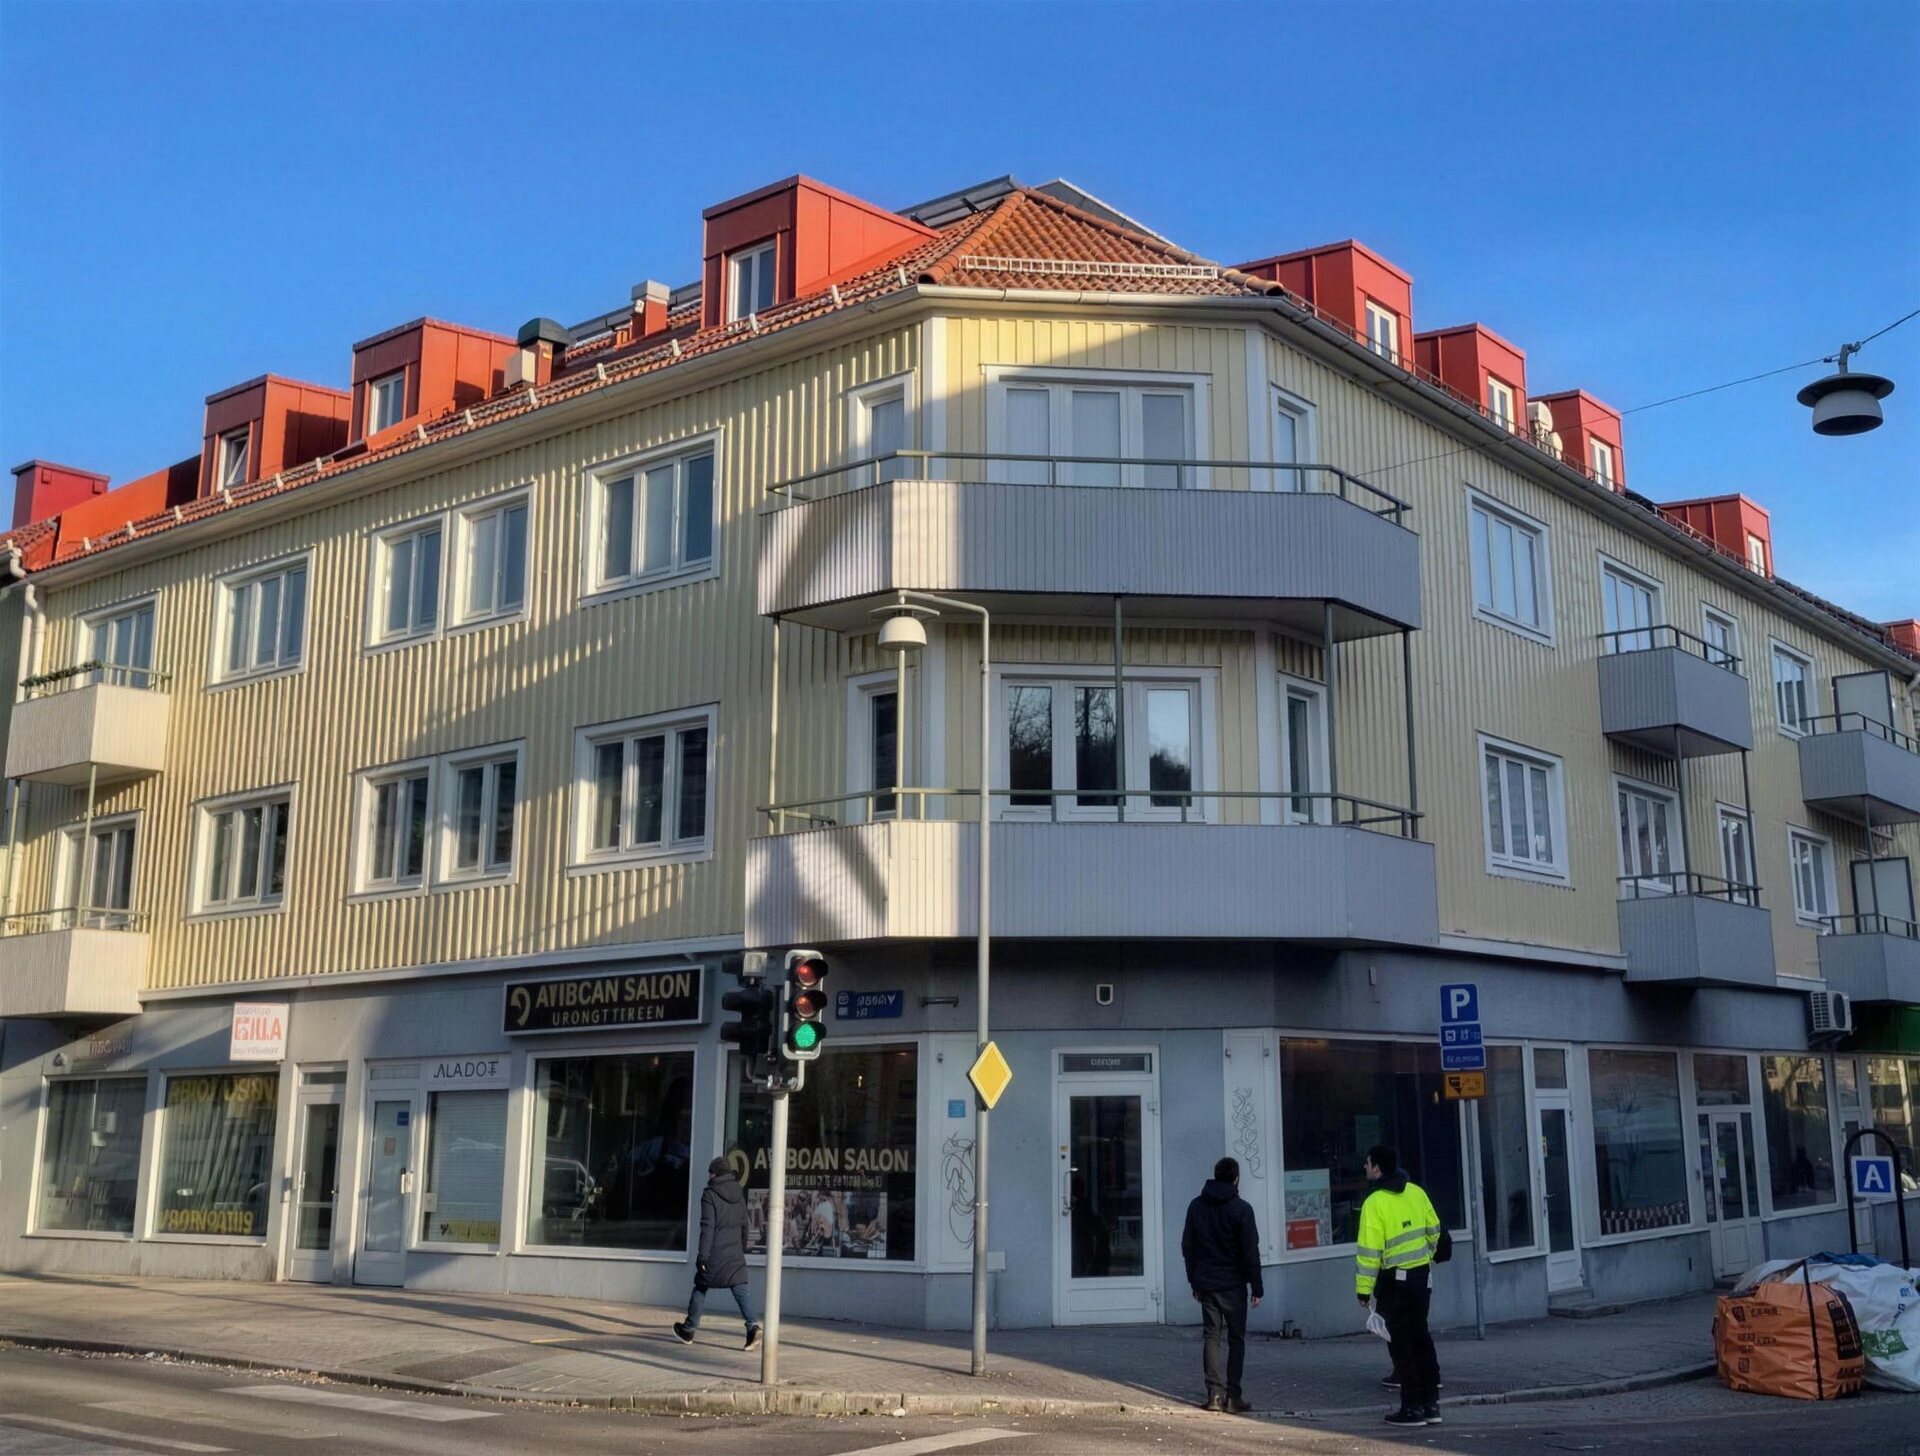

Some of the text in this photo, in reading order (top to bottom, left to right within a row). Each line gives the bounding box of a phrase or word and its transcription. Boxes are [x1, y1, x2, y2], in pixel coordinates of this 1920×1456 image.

[624, 972, 691, 1002] SALON
[1450, 988, 1470, 1019] P
[844, 1147, 909, 1172] SALON
[1863, 1164, 1885, 1189] A
